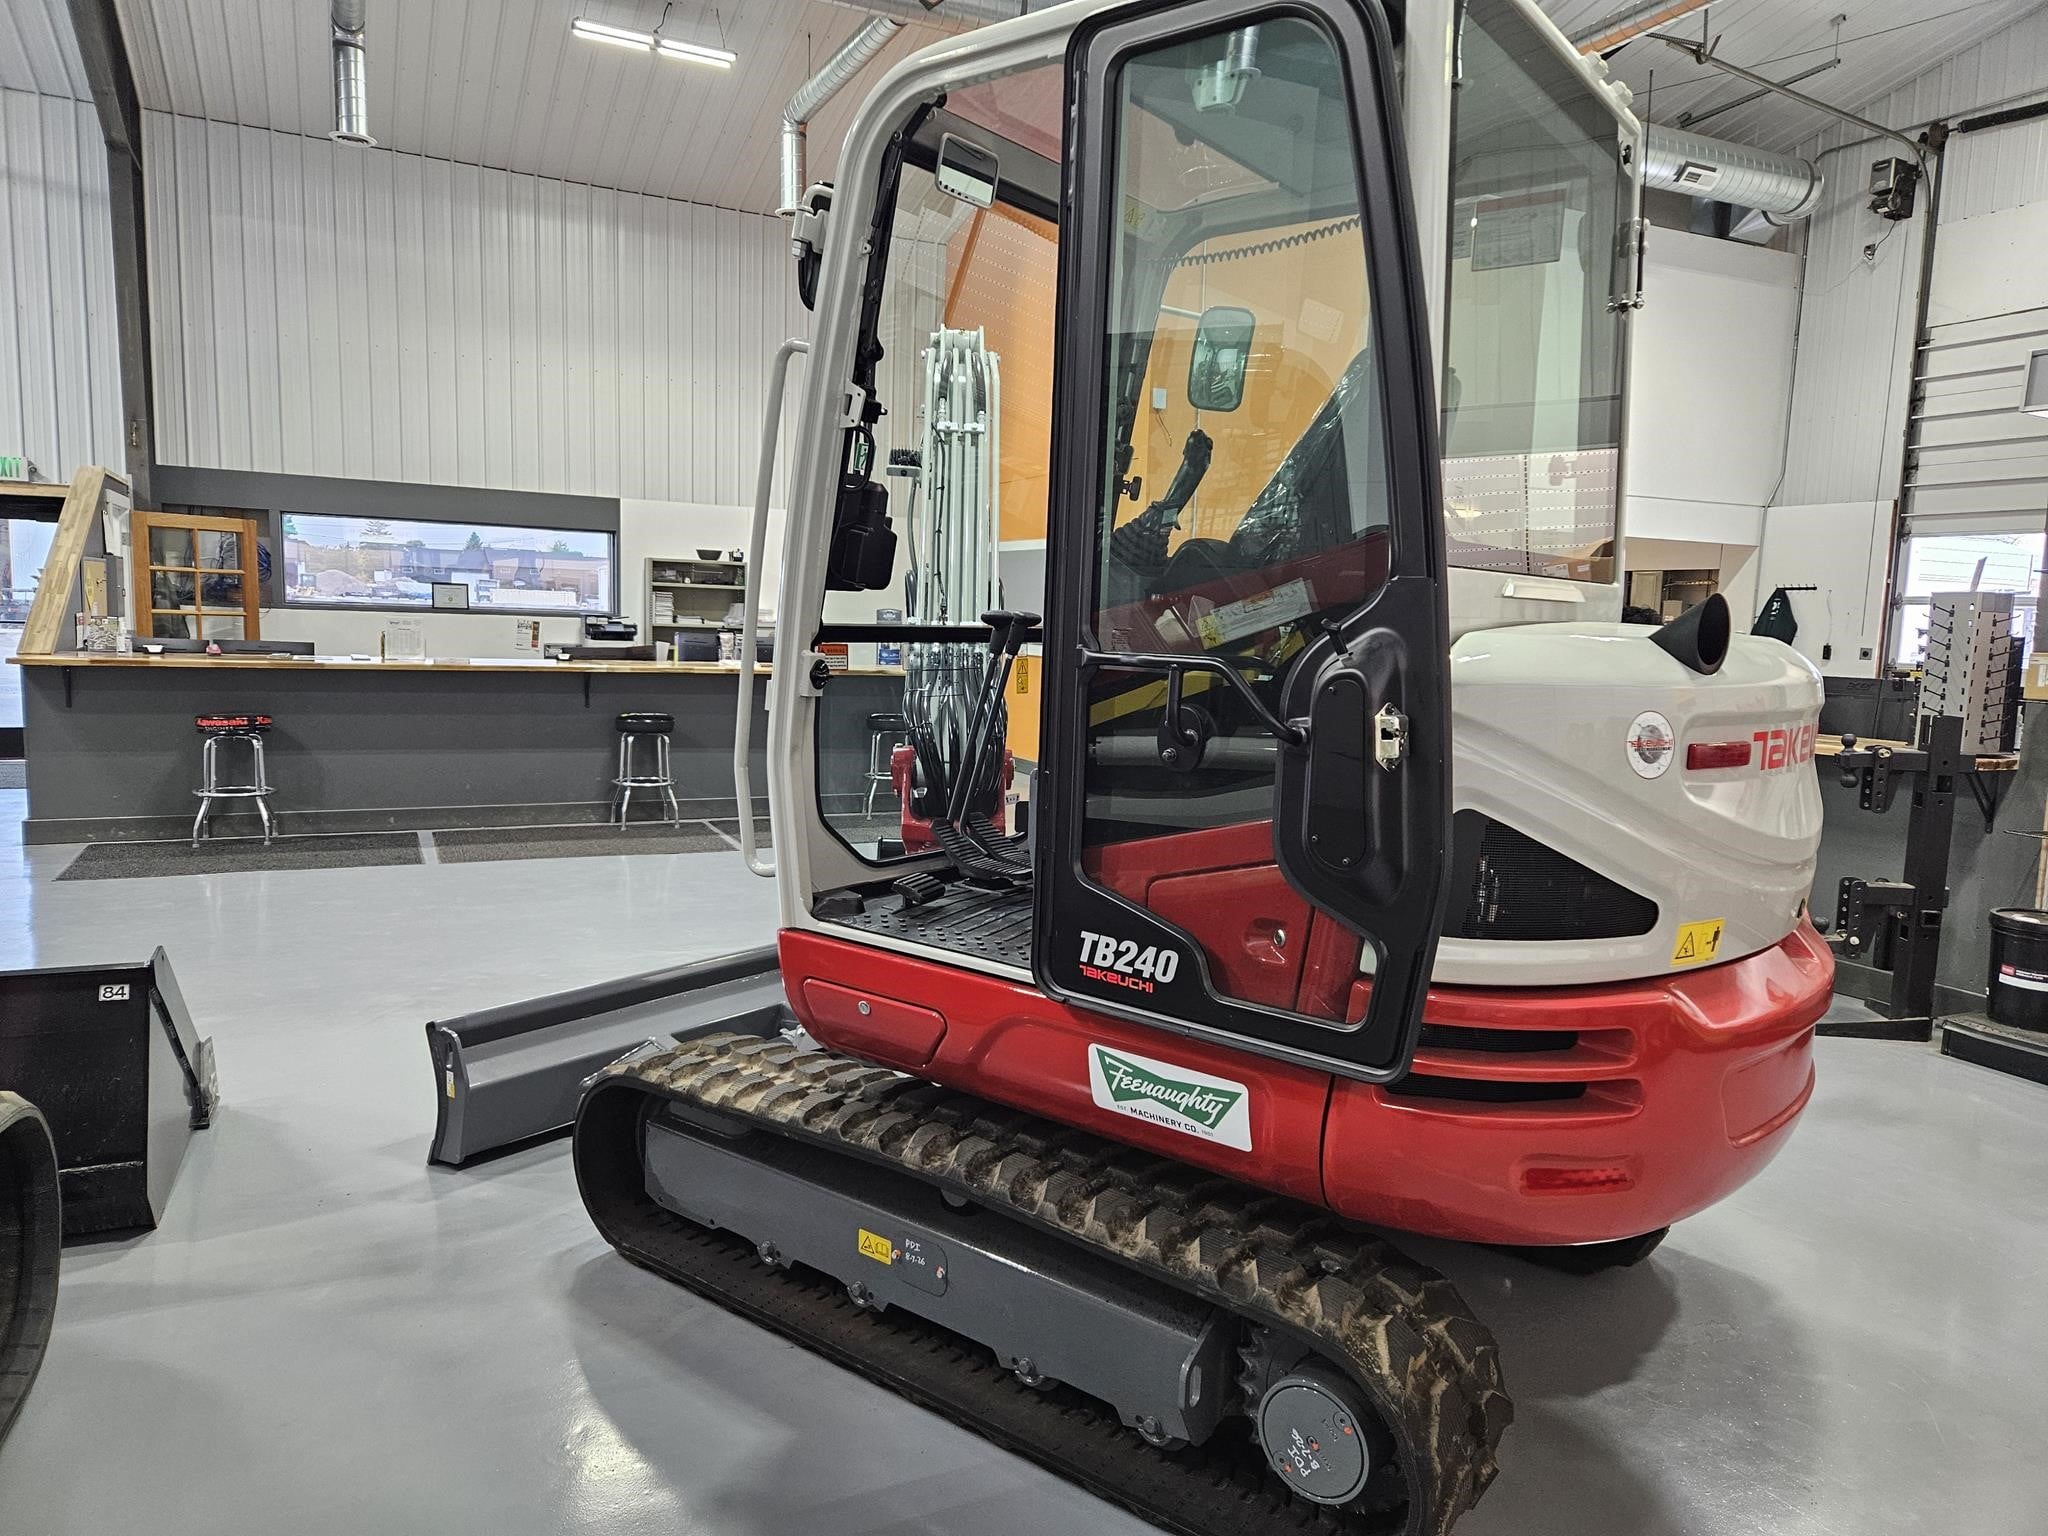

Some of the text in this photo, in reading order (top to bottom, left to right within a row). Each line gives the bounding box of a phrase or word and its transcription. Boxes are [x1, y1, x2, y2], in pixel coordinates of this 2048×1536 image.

[0, 456, 22, 478] XIT
[1079, 930, 1179, 983] TB240
[102, 986, 127, 998] 84
[1079, 964, 1154, 993] TAKEUCHI
[1104, 1055, 1230, 1125] Feenaughty
[1130, 1107, 1182, 1128] MACHINERY
[1184, 1123, 1200, 1133] CO.
[905, 1238, 921, 1252] PDI
[1287, 1445, 1311, 1477] PDI
